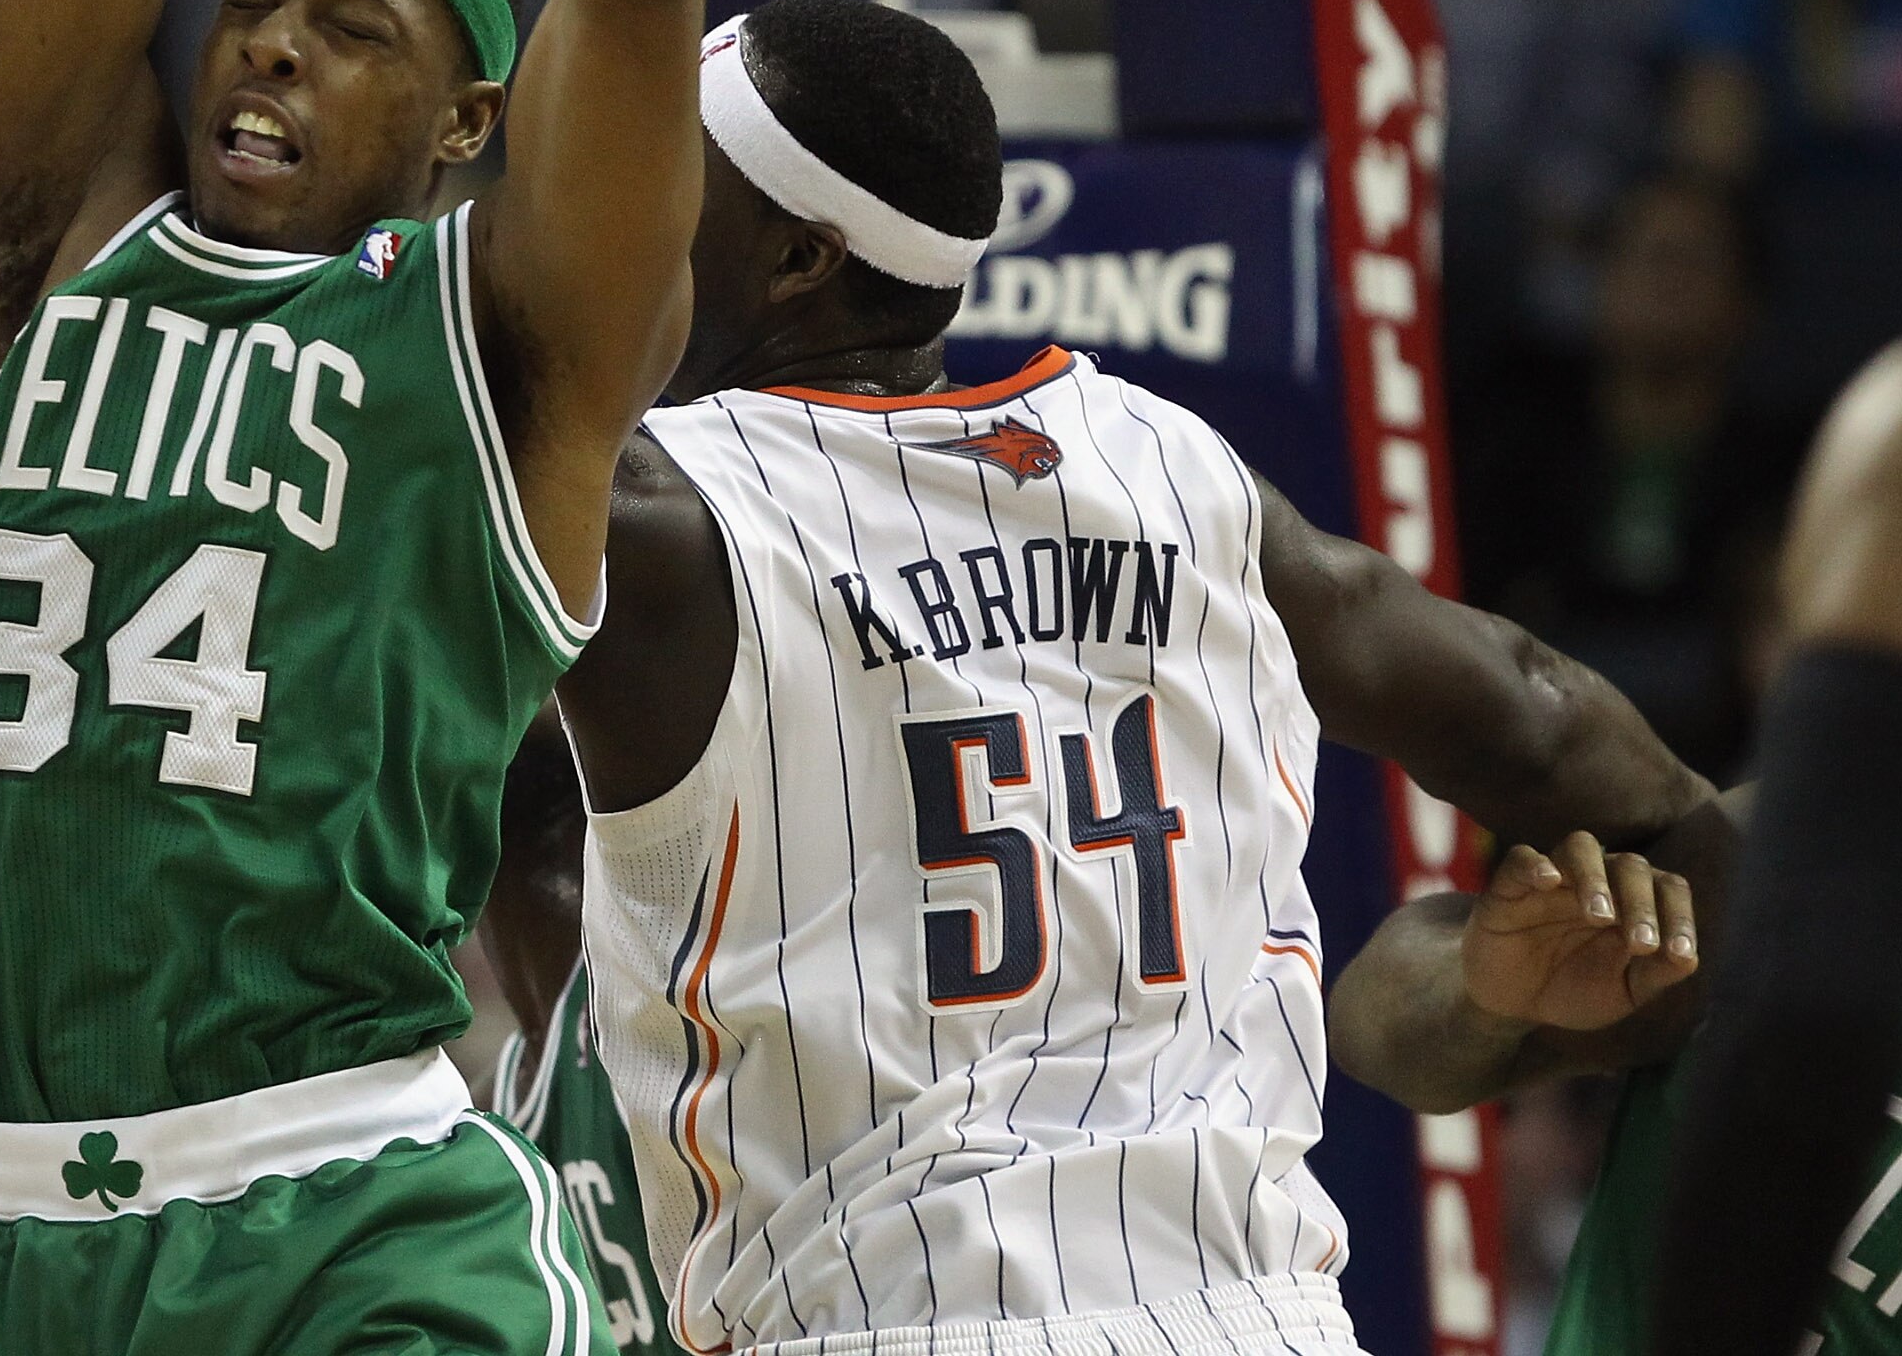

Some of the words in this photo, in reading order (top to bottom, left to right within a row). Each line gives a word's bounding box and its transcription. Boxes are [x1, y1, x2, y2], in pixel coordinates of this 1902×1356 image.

[947, 243, 1235, 363] LDING
[831, 536, 1179, 671] K.BROWN
[901, 689, 1188, 1011] 54
